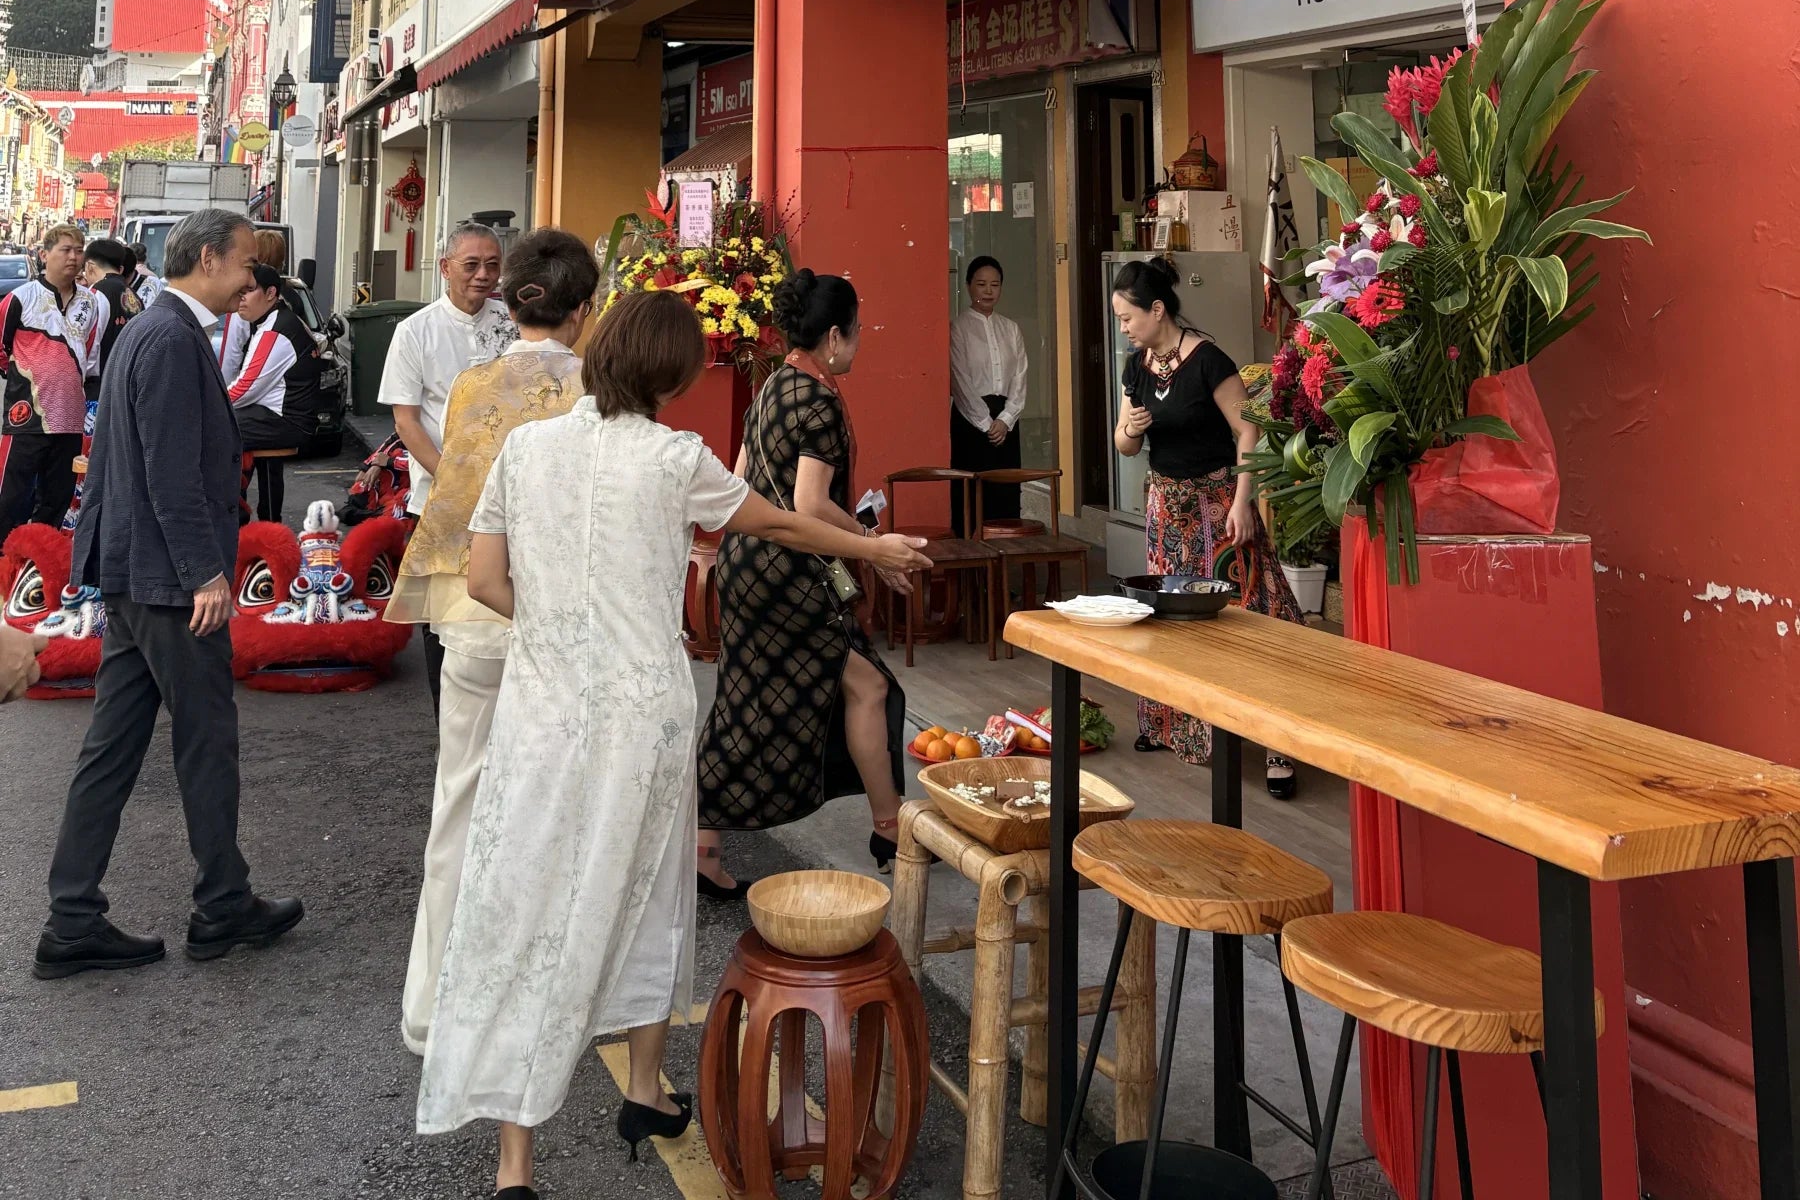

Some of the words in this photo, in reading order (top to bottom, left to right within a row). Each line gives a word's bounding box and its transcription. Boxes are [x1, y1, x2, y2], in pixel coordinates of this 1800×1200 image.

[947, 13, 980, 58] 服饰
[976, 56, 990, 72] ALL
[990, 51, 1013, 69] ITEMS
[1024, 45, 1042, 62] LOW
[132, 103, 161, 114] NAM
[711, 86, 724, 115] 5M
[1044, 87, 1058, 110] 22
[362, 164, 370, 188] 16
